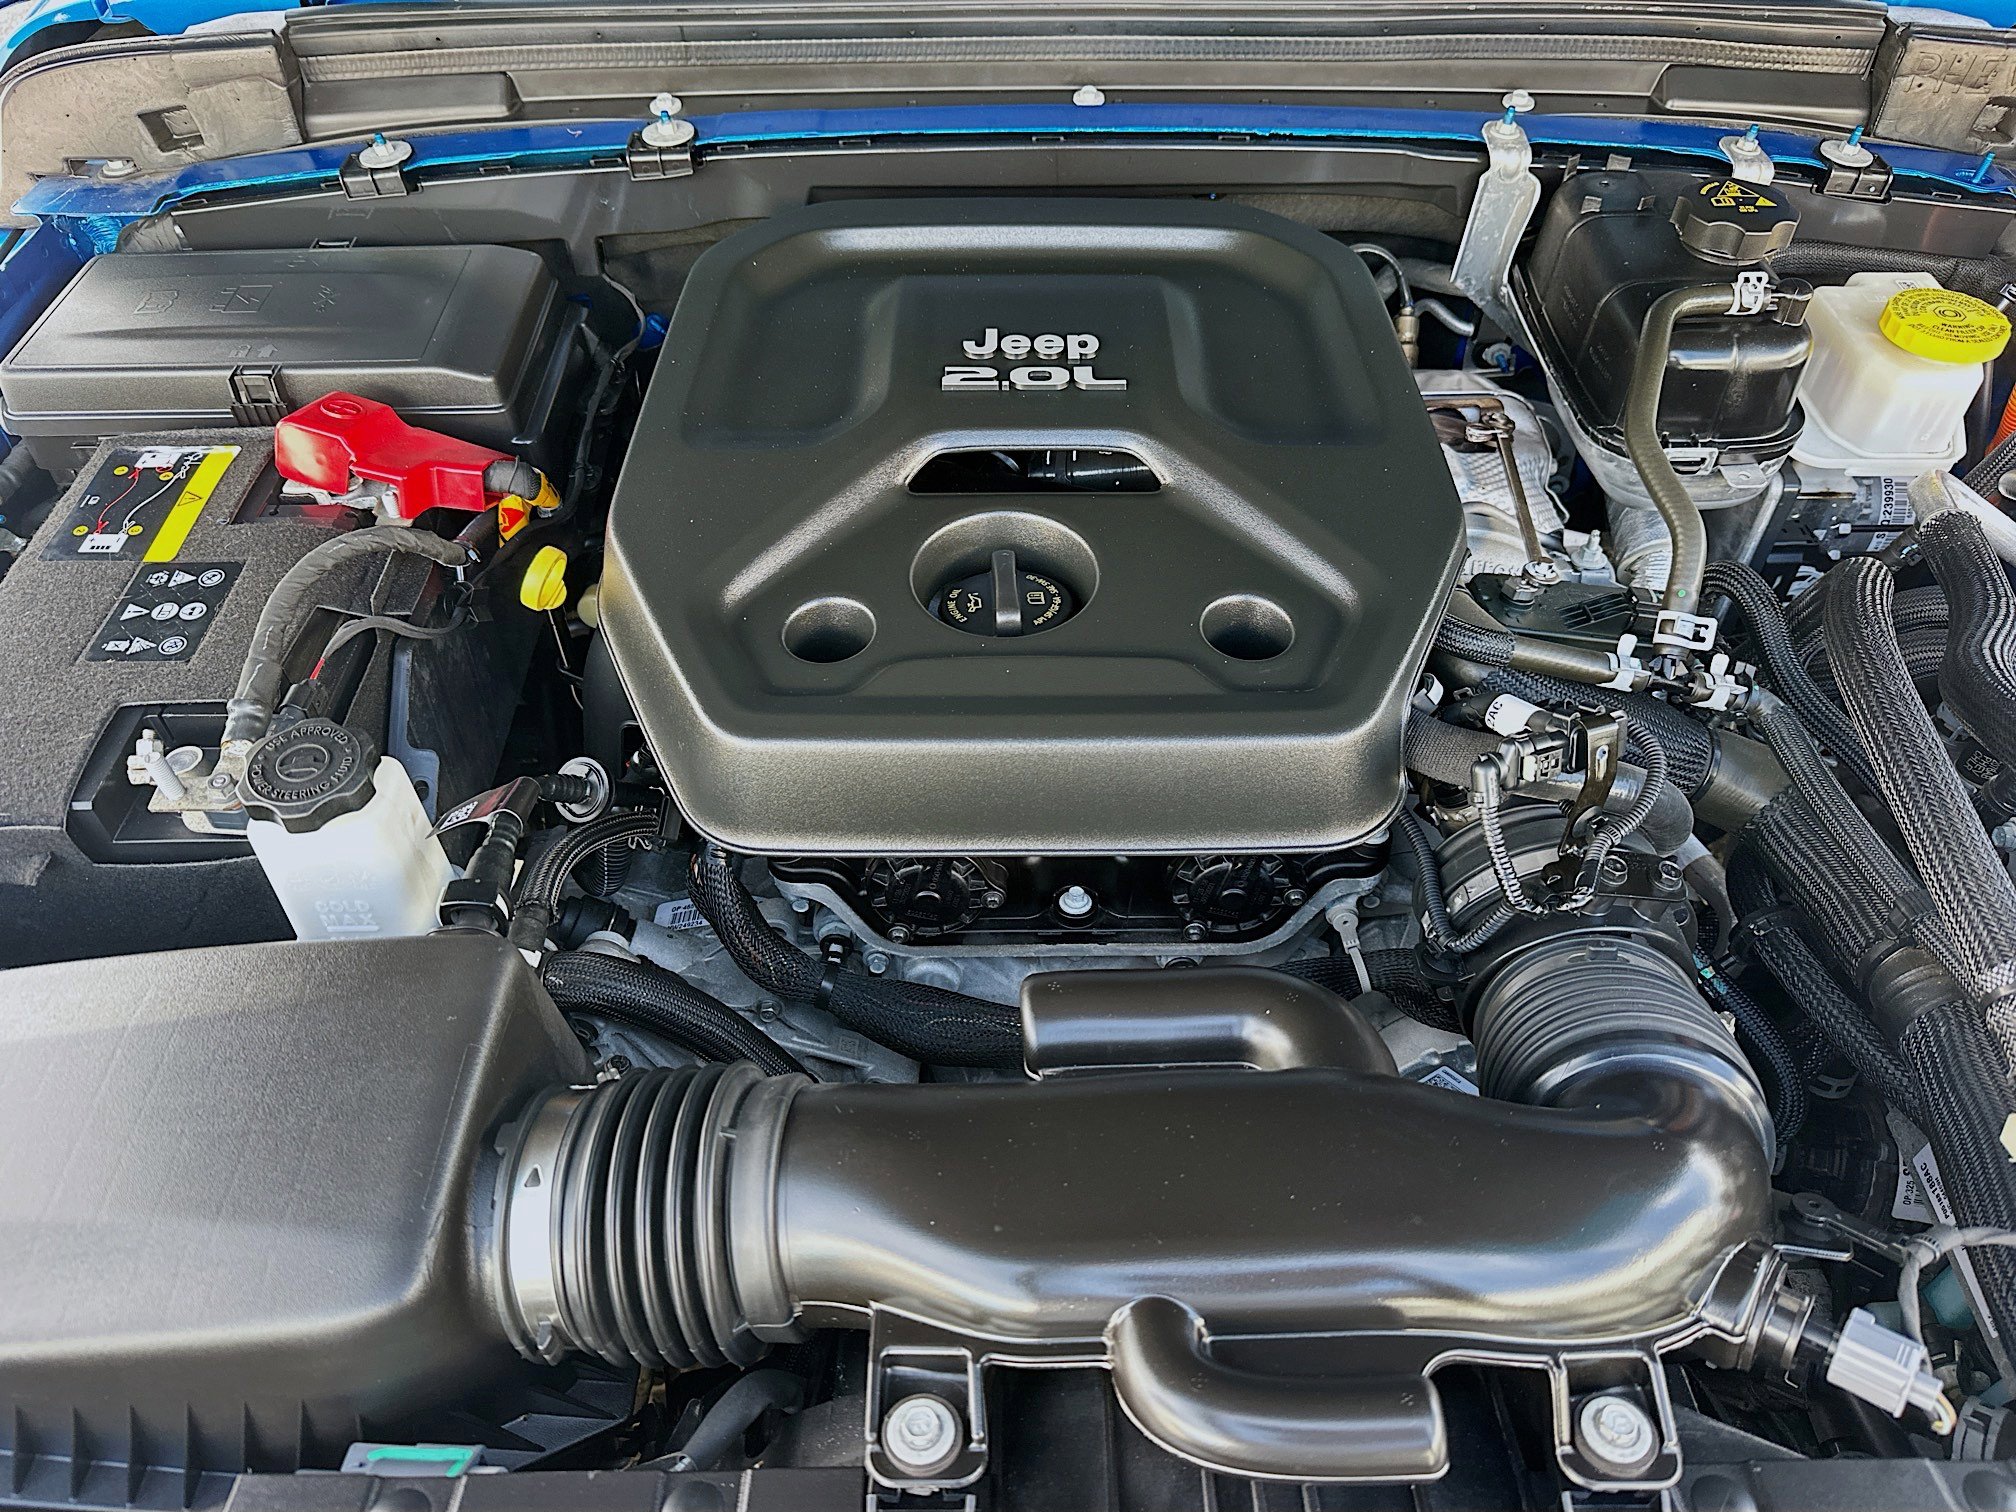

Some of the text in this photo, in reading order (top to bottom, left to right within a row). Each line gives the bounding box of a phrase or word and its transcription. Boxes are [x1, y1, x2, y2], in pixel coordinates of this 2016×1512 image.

[1903, 52, 2016, 94] PHE
[962, 327, 1100, 363] Jeep
[941, 365, 1128, 391] 2.0L
[947, 588, 968, 623] ENGINE OIL
[265, 726, 349, 752] USE APPROVED
[1963, 750, 1983, 771] CHLR
[1972, 755, 1992, 777] PHEV
[251, 755, 353, 800] POWER STEERING FLUID
[314, 899, 371, 914] COLD
[319, 912, 377, 927] MAX
